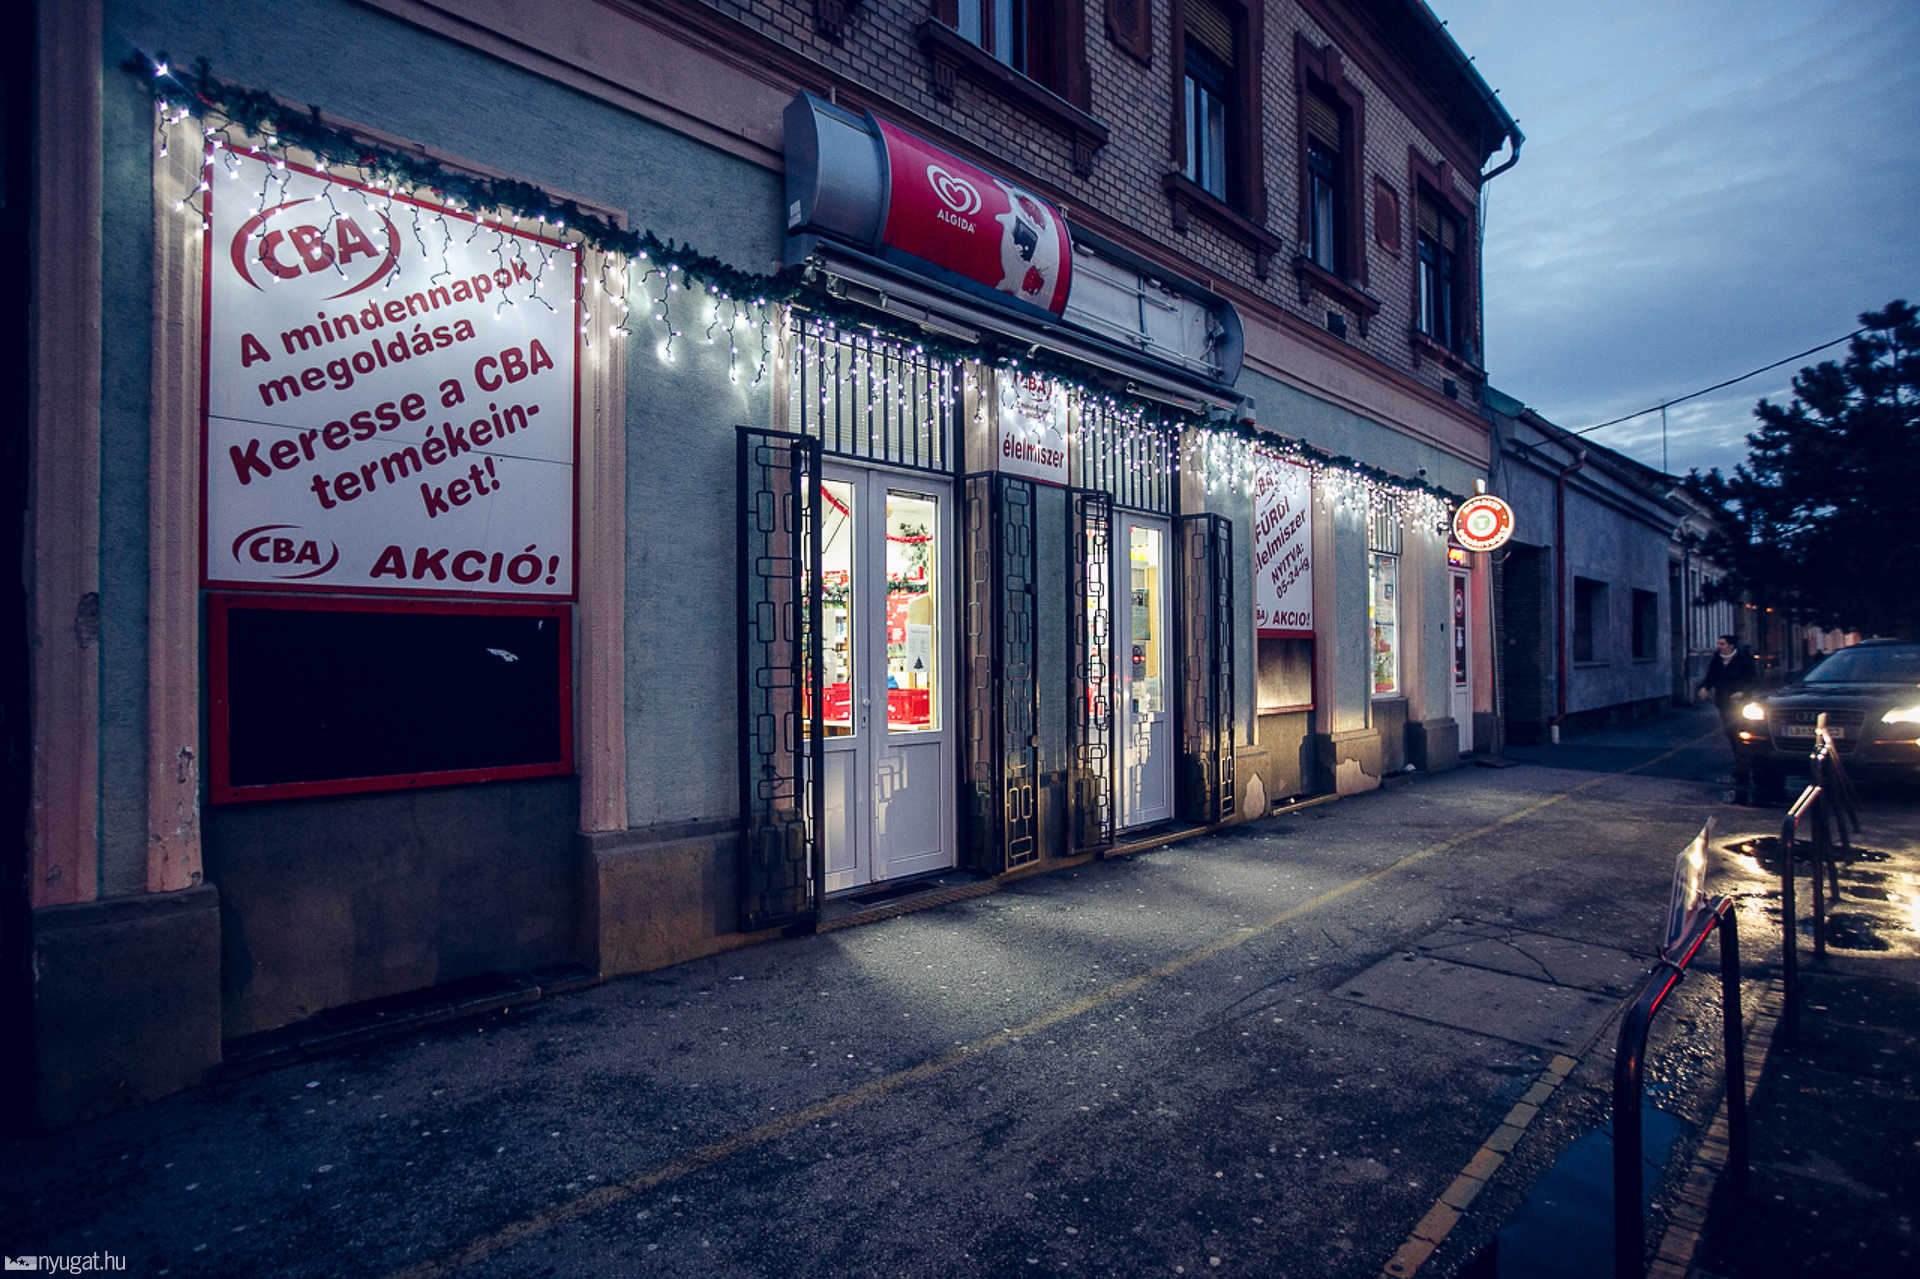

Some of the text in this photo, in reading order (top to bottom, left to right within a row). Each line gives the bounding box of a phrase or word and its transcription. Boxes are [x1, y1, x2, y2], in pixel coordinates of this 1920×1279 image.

[259, 215, 380, 279] CBA
[937, 208, 976, 234] ALGIDA
[240, 257, 533, 368] A mindennapok
[258, 318, 476, 407] megoldása
[229, 338, 555, 486] Keresse a CBA
[310, 402, 540, 510] termékein-
[1002, 431, 1065, 469] élelmiszer
[420, 455, 501, 519] ket!
[1256, 471, 1274, 496] BA
[249, 535, 561, 586] CBA AKCIÓ!
[1255, 509, 1306, 575] lelmiszer
